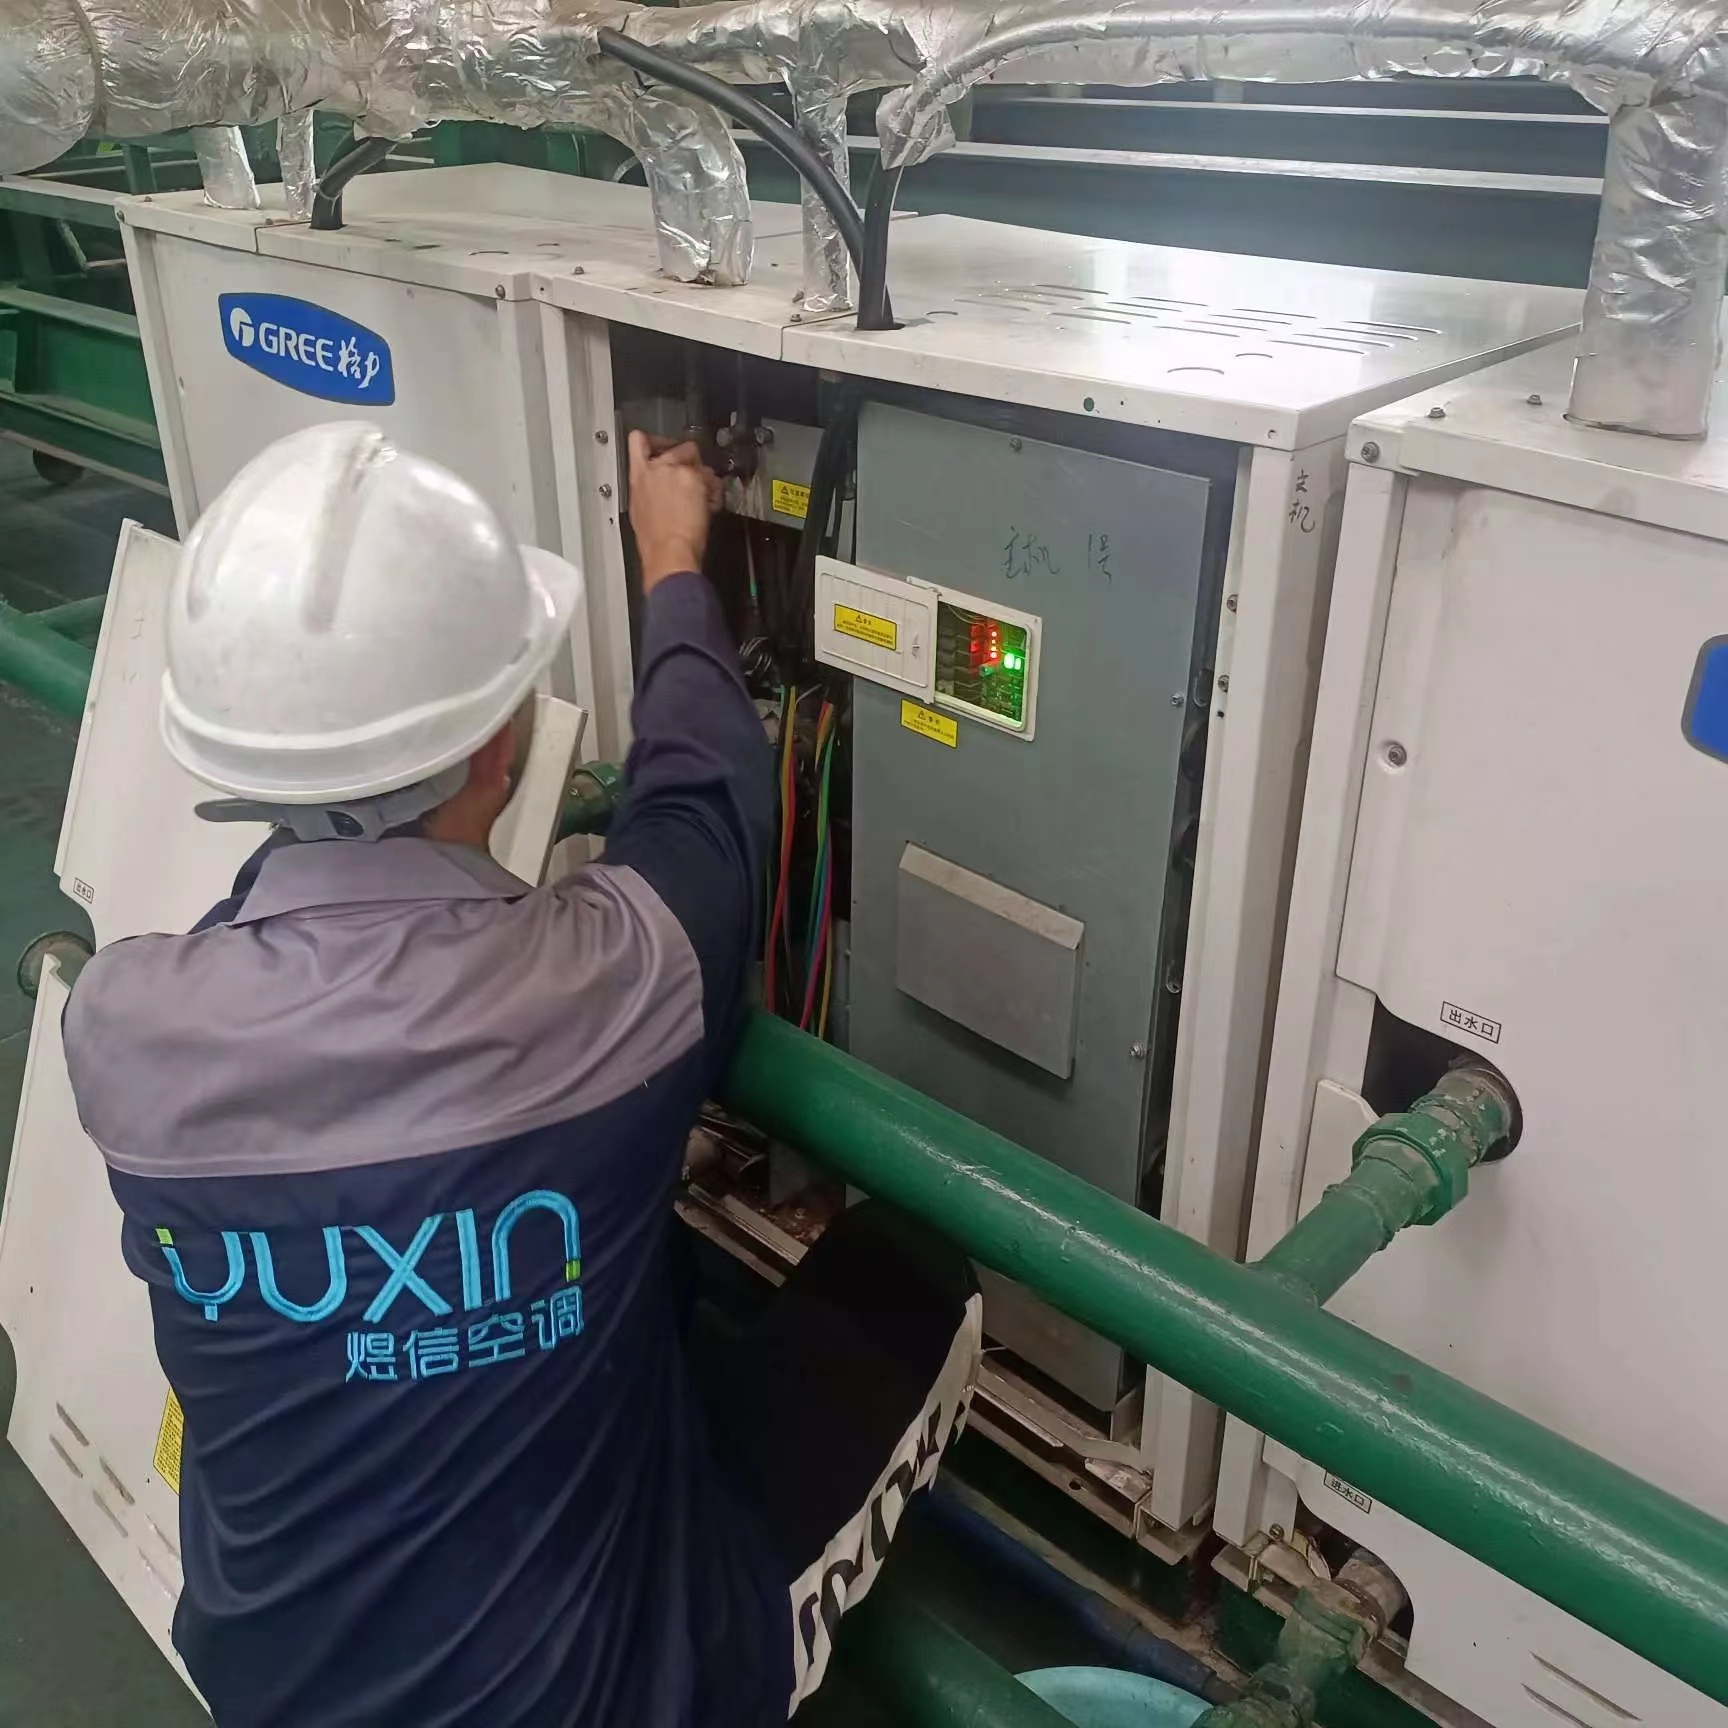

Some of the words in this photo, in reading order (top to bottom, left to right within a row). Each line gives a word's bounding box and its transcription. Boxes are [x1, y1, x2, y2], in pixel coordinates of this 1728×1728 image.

[259, 322, 334, 371] GREE
[338, 337, 380, 389] 格力
[1449, 1009, 1494, 1037] 出水口
[345, 1284, 585, 1384] 煜信空调
